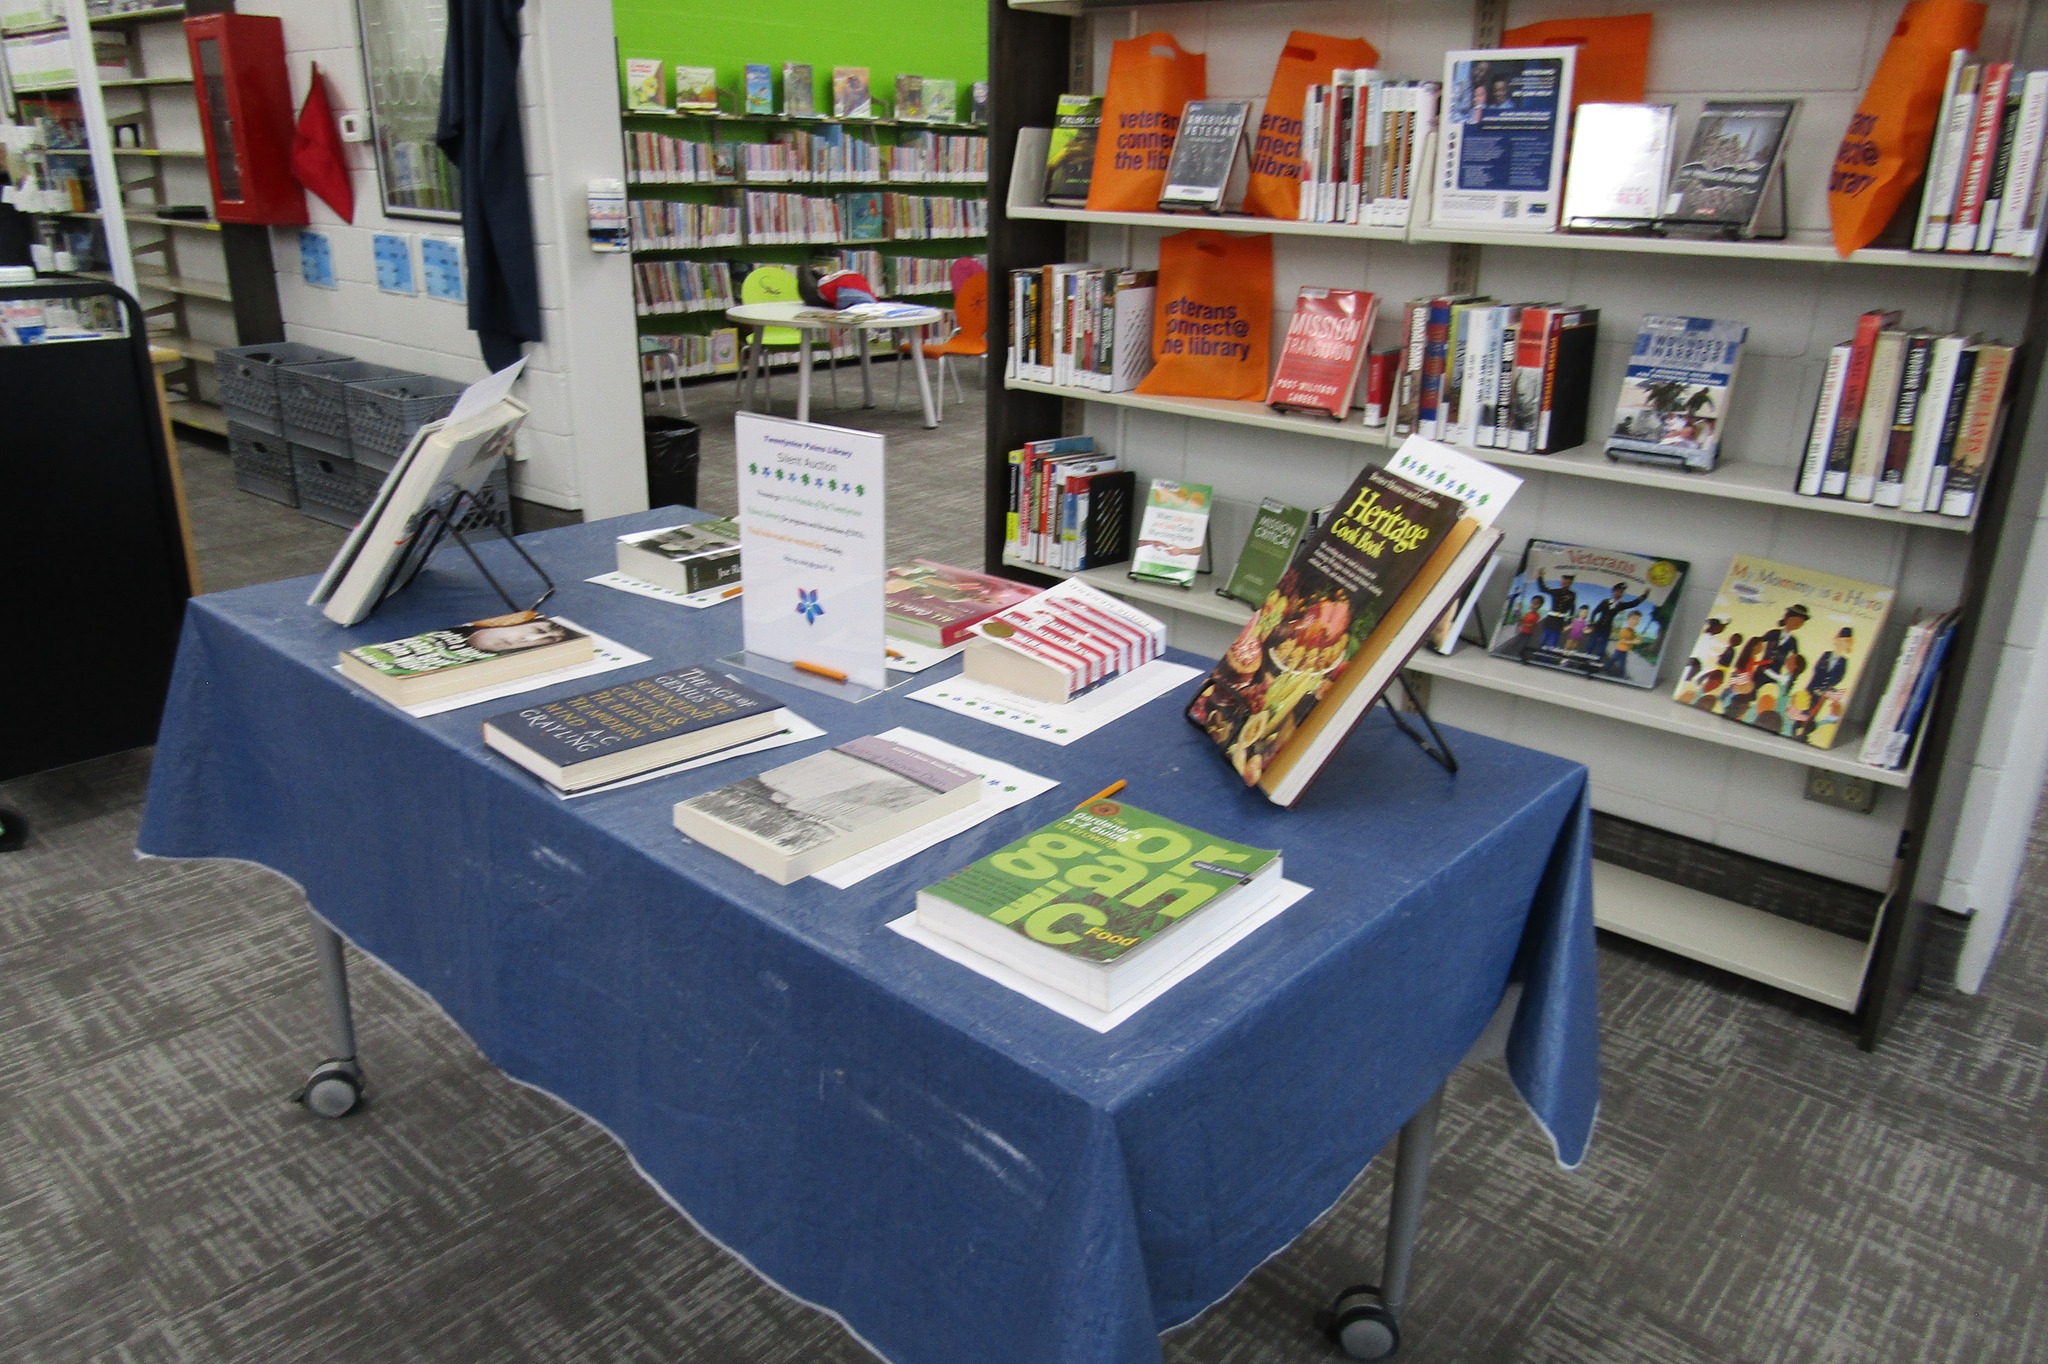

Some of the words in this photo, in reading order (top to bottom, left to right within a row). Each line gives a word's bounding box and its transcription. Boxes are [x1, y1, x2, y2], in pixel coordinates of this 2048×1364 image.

[1119, 111, 1180, 130] veteran
[1184, 126, 1239, 138] VETERAN
[1187, 114, 1242, 127] AMERICAN
[1117, 131, 1176, 150] conne
[1114, 152, 1143, 170] the
[1165, 318, 1249, 338] onnect@
[1288, 312, 1361, 342] MISSION
[1161, 338, 1184, 355] he
[1188, 337, 1251, 362] library
[777, 452, 803, 466] Silent
[827, 446, 854, 460] Library
[1259, 515, 1298, 538] MISSION
[1343, 485, 1430, 554] Heritage
[1254, 527, 1292, 549] CRITICAL
[1330, 516, 1361, 546] Cook
[1356, 529, 1386, 560] Book
[1567, 548, 1638, 575] Veterans
[1731, 563, 1757, 584] My
[654, 674, 707, 704] GENIUS
[678, 667, 712, 690] THE
[704, 685, 739, 702] AGE
[734, 696, 759, 710] OF
[542, 702, 588, 729] MIND
[608, 701, 652, 727] BIRTH
[646, 721, 673, 734] OF
[611, 686, 677, 721] CENTURY
[667, 715, 689, 728] &
[519, 707, 600, 754] GRAYLING
[591, 708, 648, 741] MODERN
[1054, 821, 1071, 831] to
[1068, 827, 1121, 850] Growing
[1089, 824, 1129, 843] Guide
[1083, 924, 1139, 949] Food
